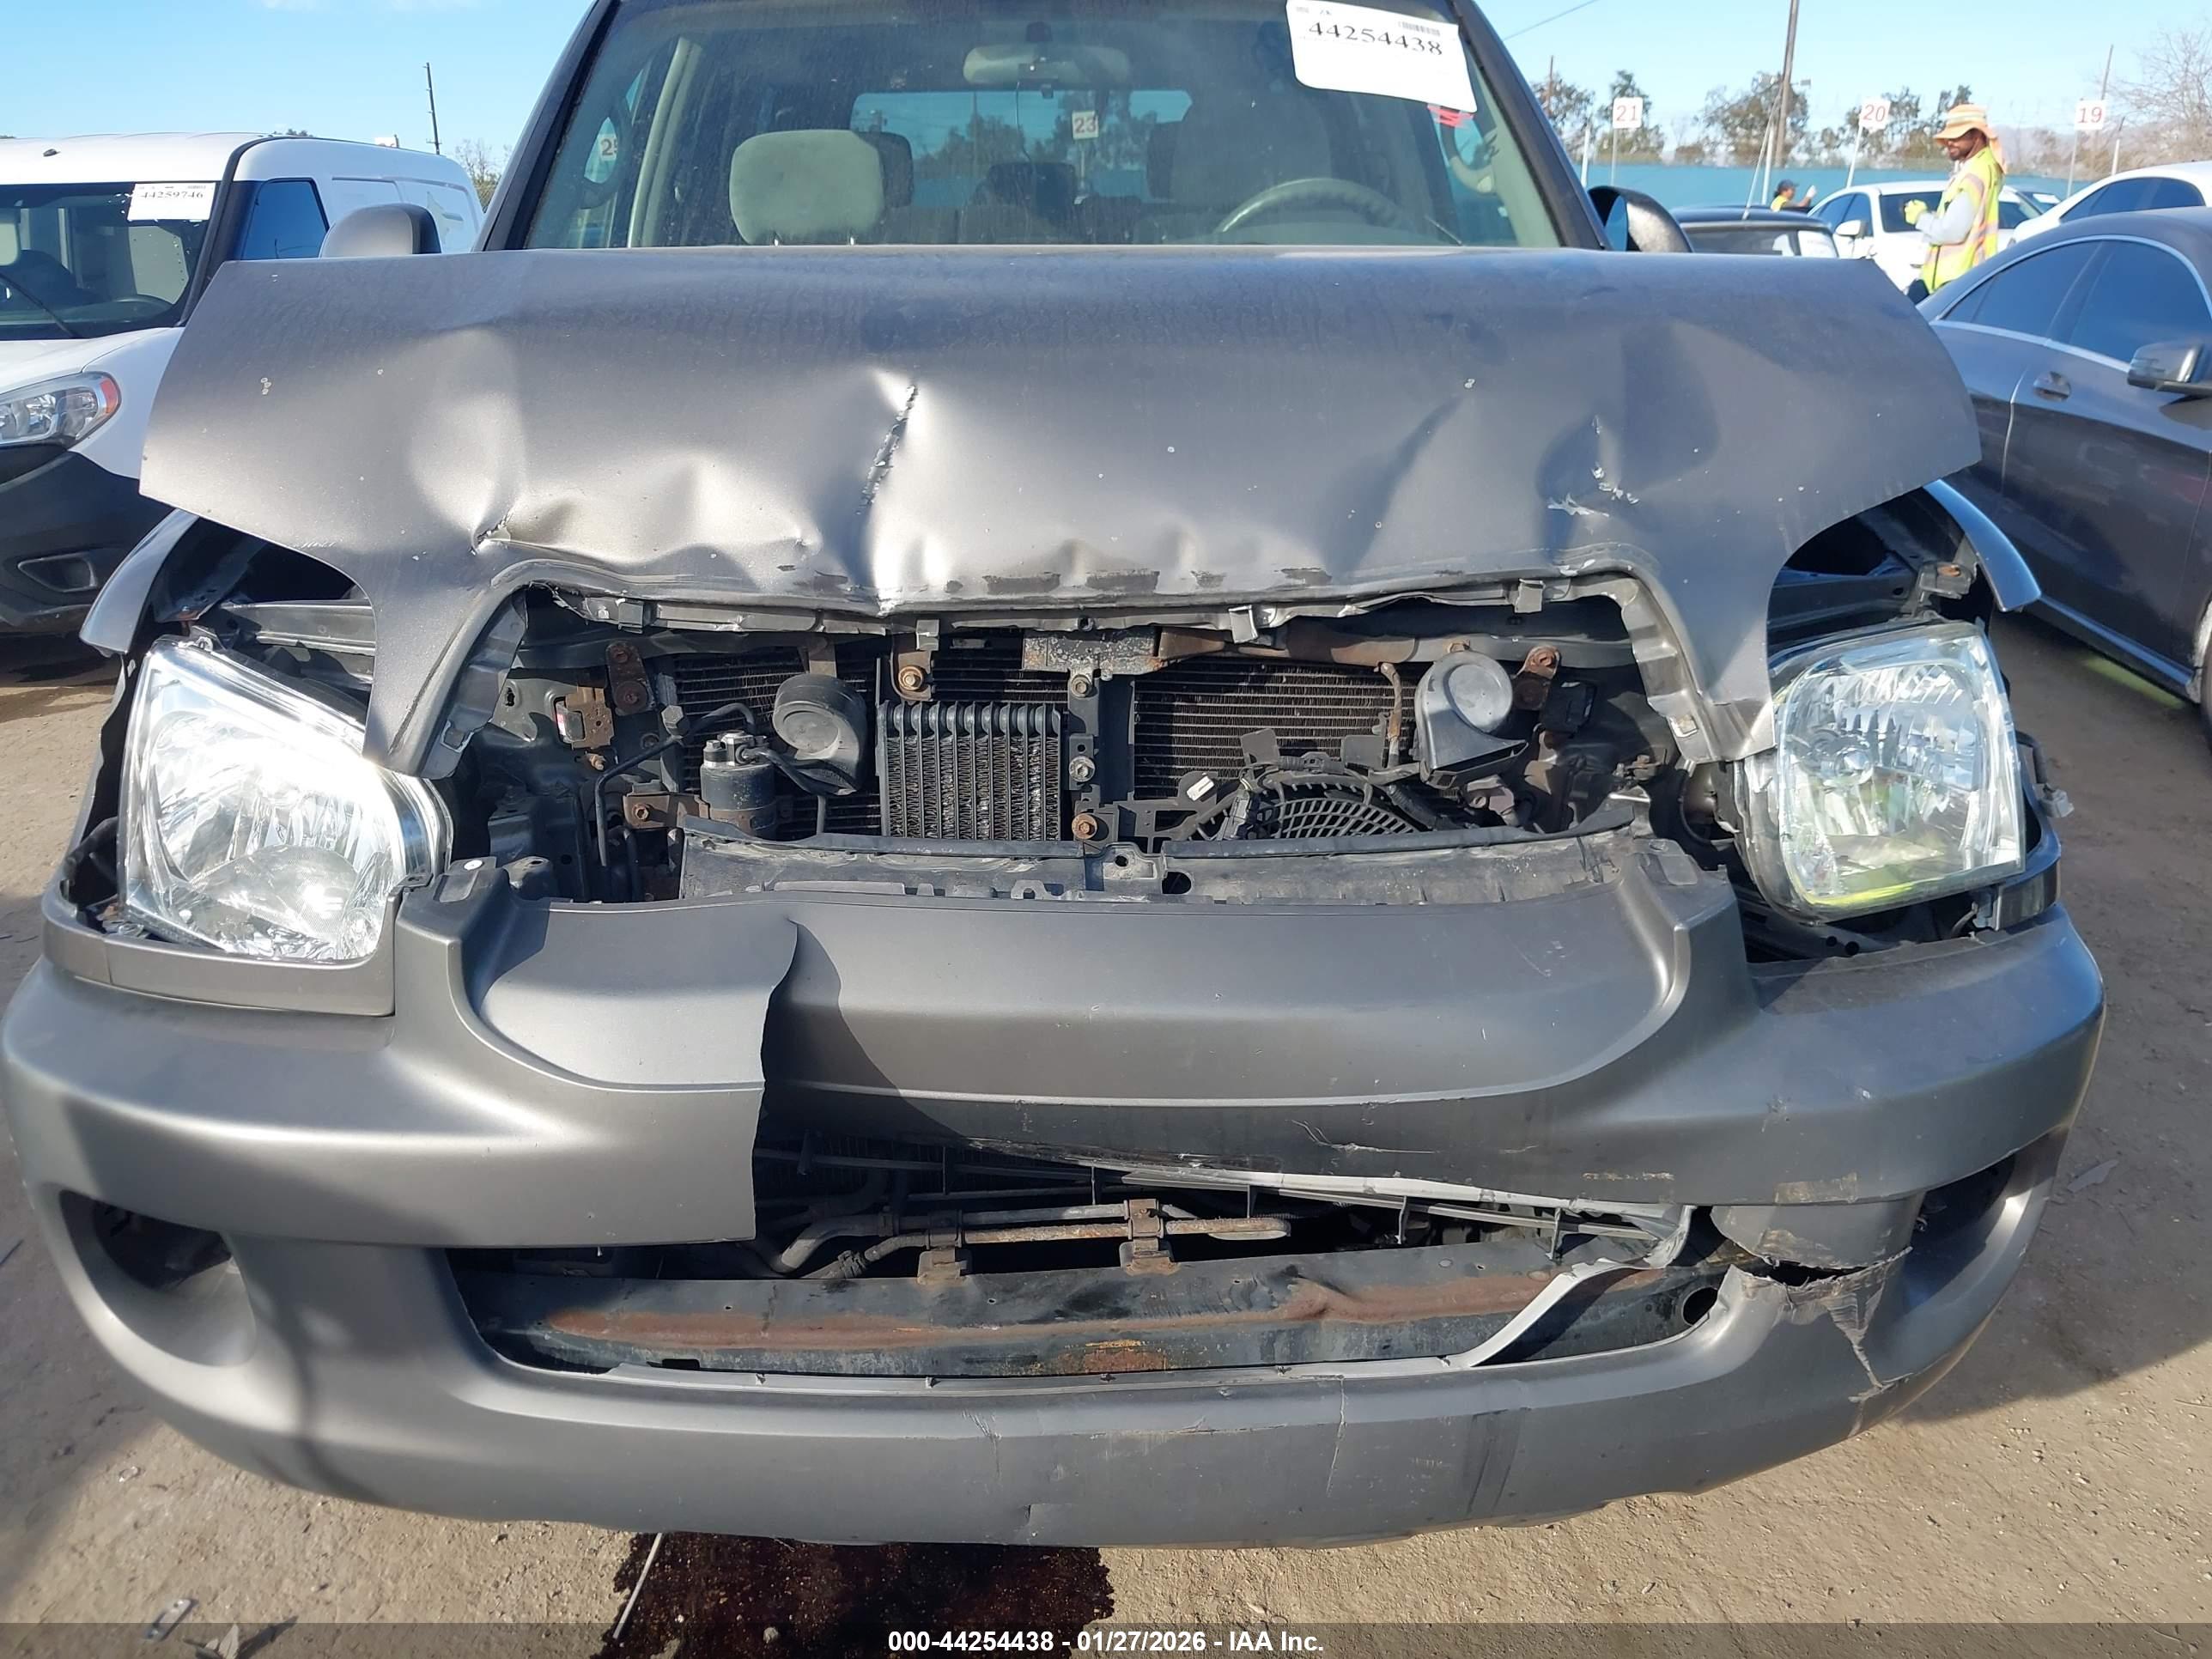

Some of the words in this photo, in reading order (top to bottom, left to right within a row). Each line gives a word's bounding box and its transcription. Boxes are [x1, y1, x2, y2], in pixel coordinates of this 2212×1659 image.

[1309, 21, 1443, 56] 44254438
[1616, 105, 1638, 122] 21
[1863, 104, 1886, 122] 20
[2078, 106, 2102, 124] 19
[1074, 118, 1097, 134] 23
[139, 191, 204, 199] 44259746
